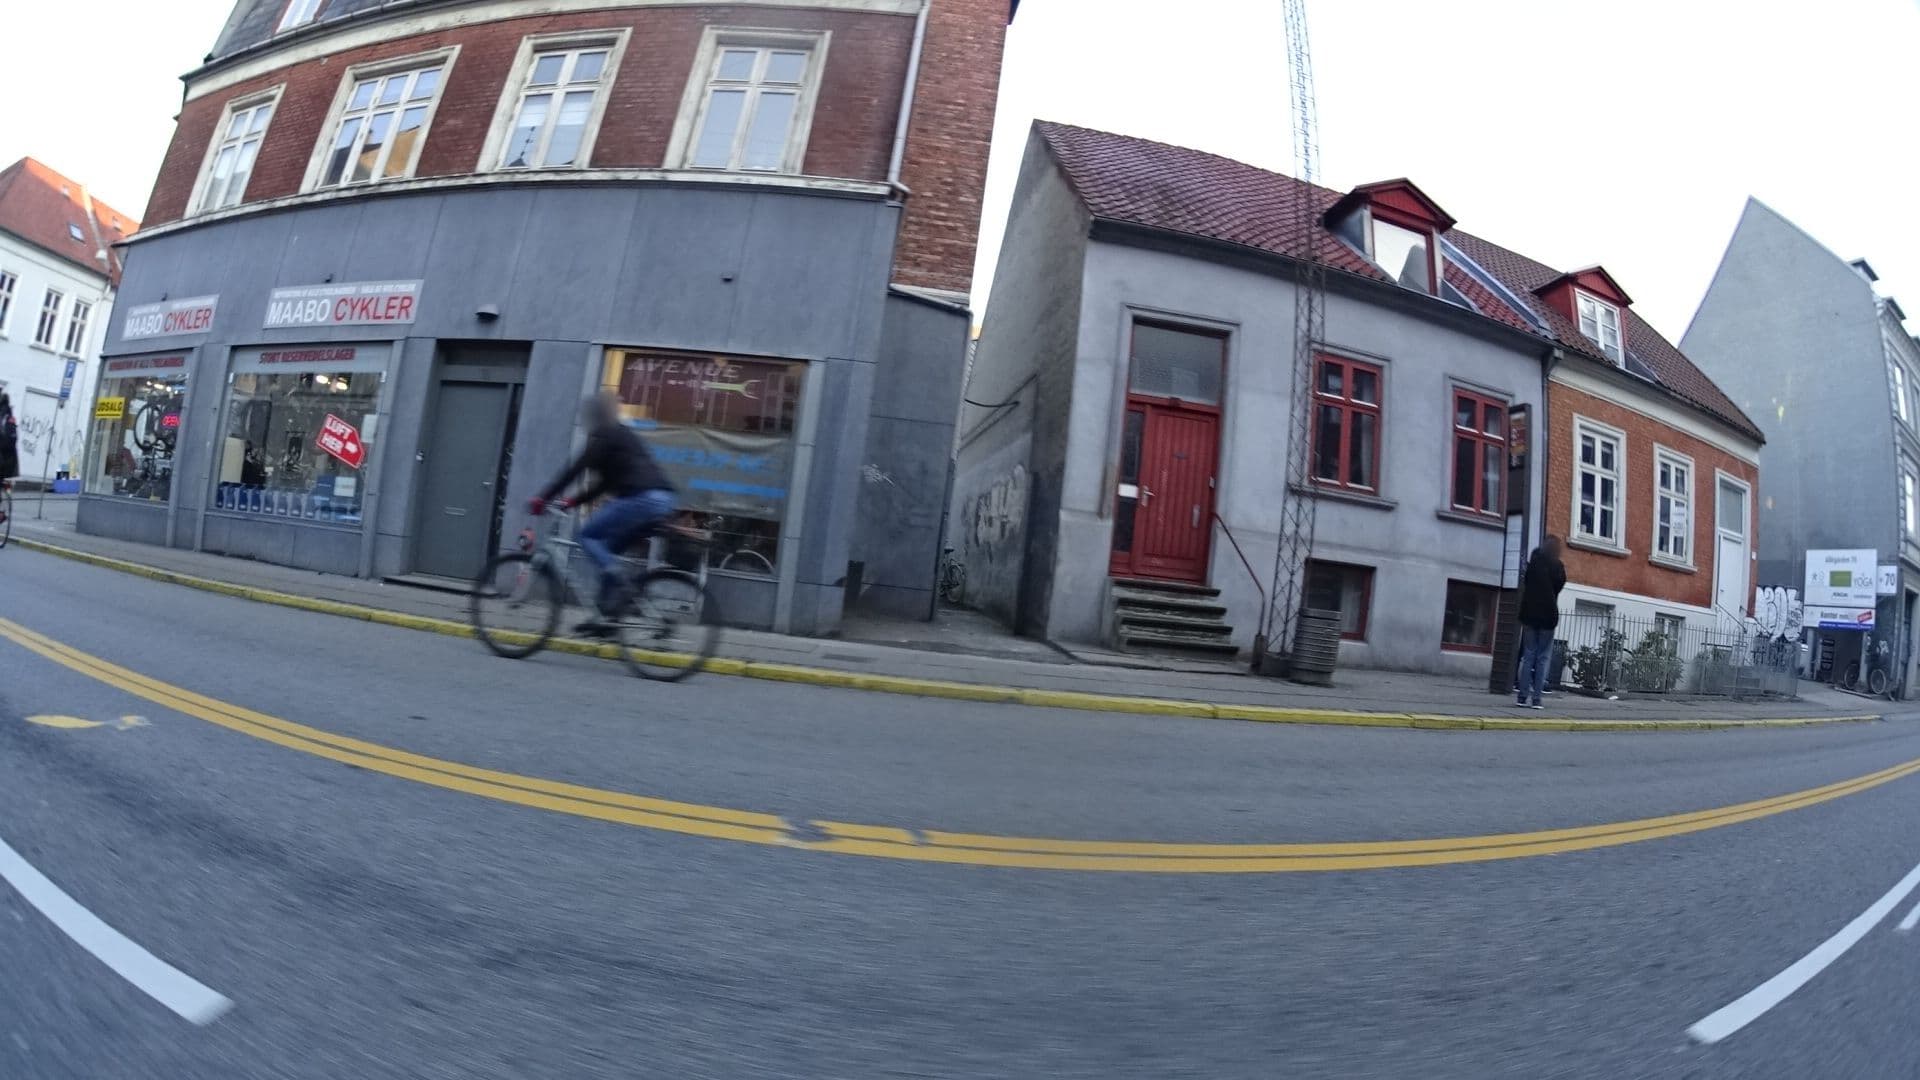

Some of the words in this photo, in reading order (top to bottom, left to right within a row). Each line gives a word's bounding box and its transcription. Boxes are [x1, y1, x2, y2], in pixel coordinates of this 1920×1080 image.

[124, 313, 163, 336] MAABO
[163, 308, 212, 332] CYKLER
[266, 299, 331, 325] MAABO
[334, 295, 413, 322] CYKLER
[627, 357, 743, 379] AVENUE
[324, 416, 353, 440] LUFT
[1885, 573, 1896, 587] 70
